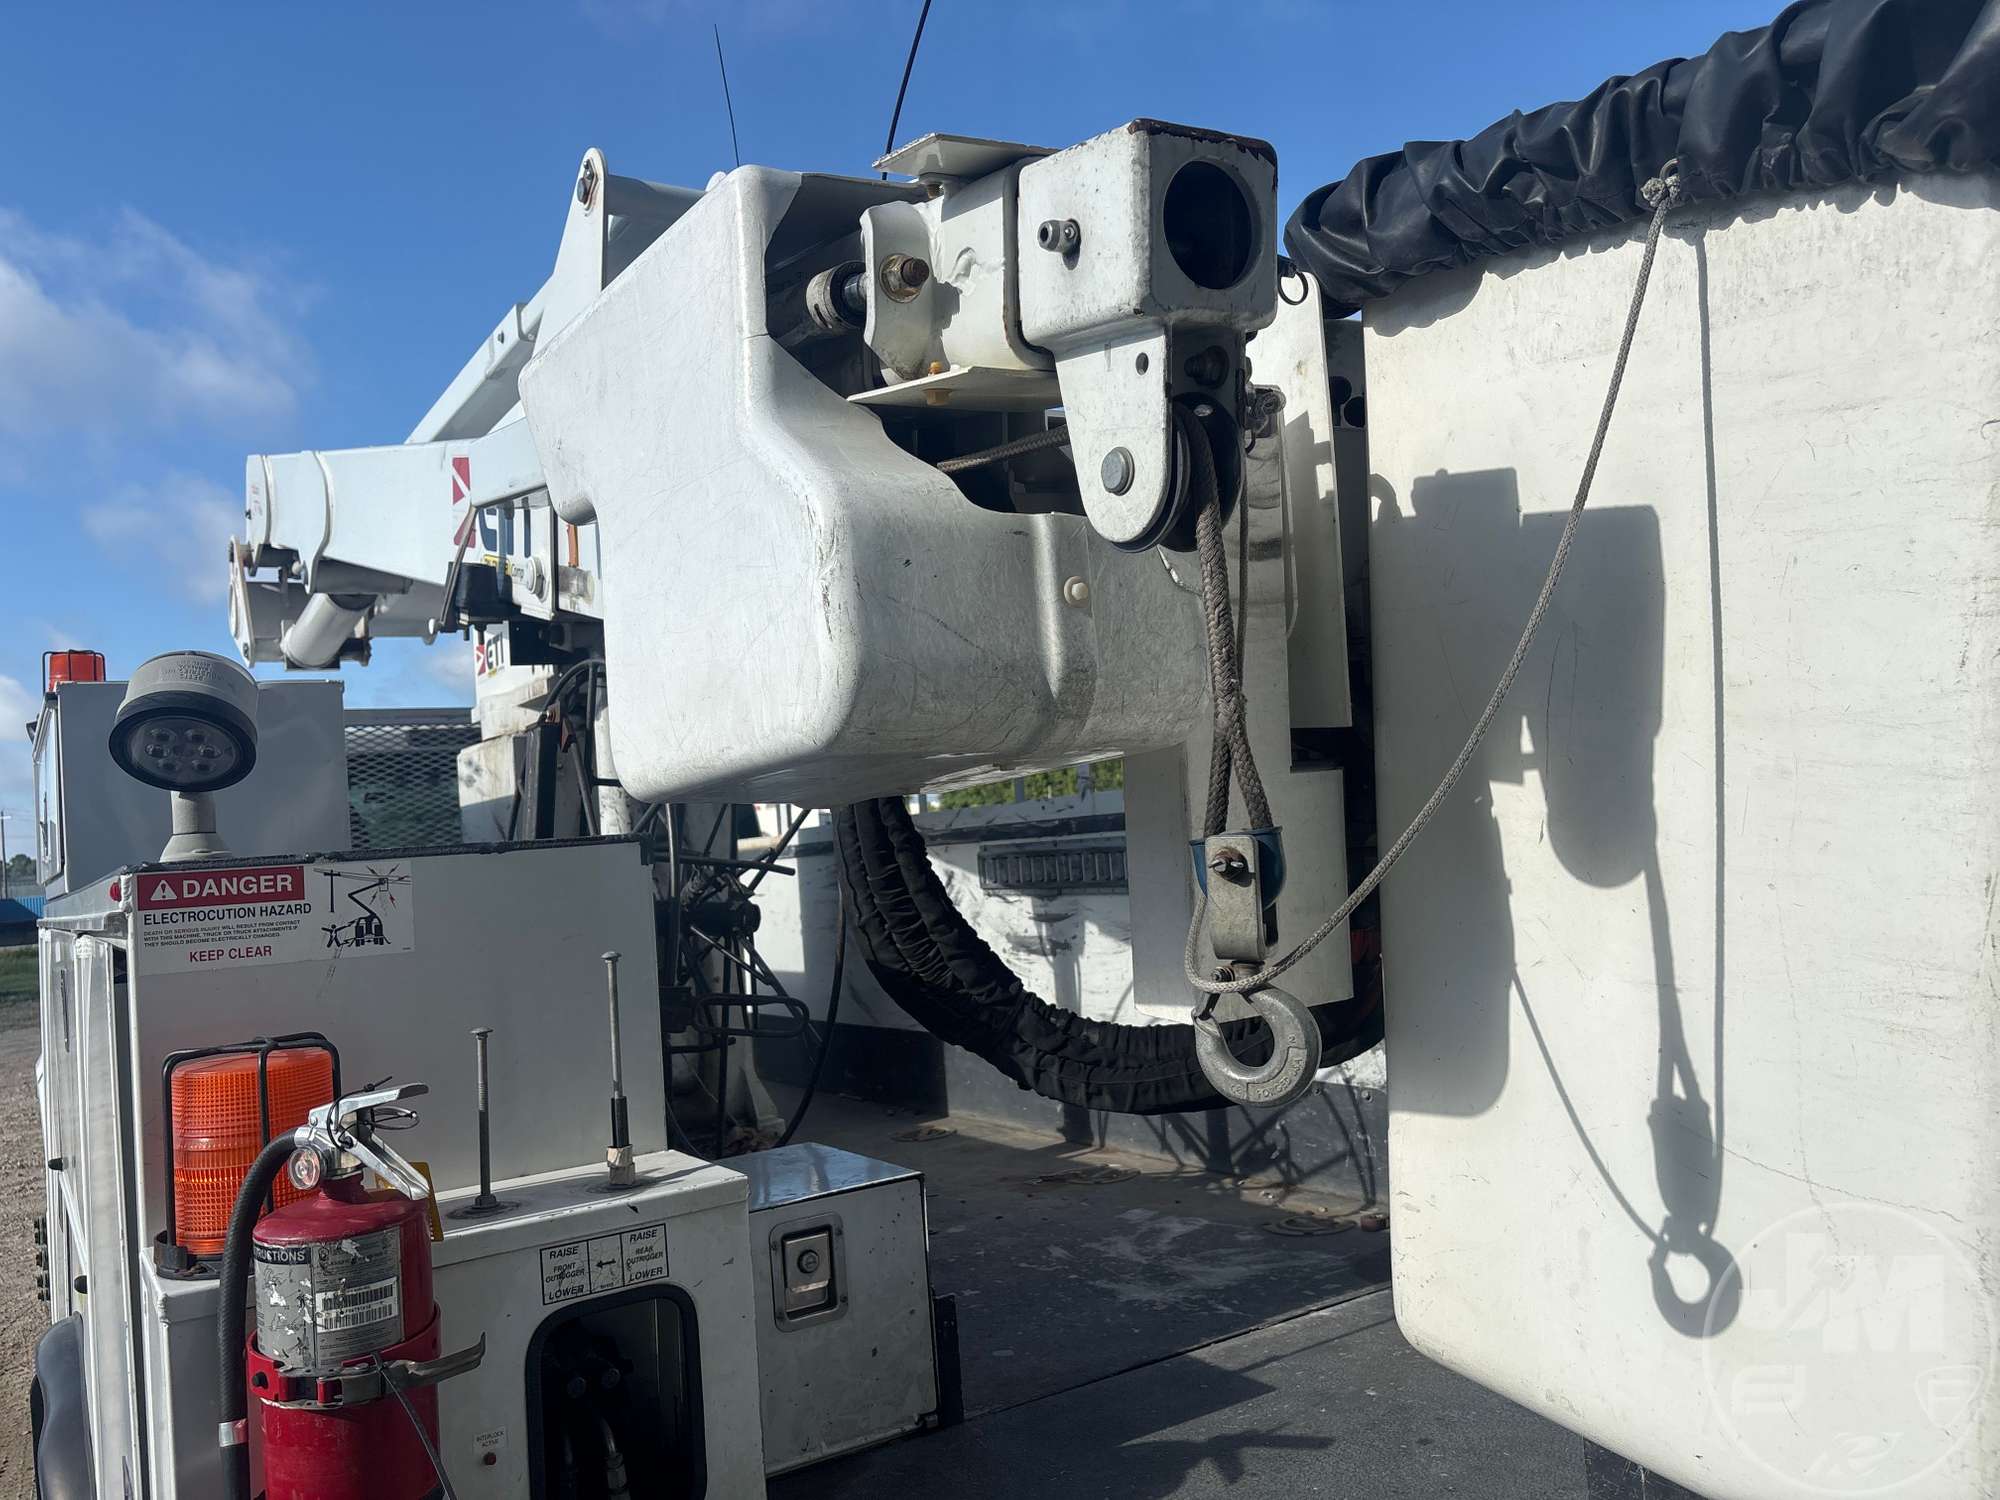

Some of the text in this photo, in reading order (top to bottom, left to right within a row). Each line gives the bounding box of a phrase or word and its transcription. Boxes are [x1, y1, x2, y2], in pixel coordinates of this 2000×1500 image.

[182, 874, 293, 899] DANGER
[144, 903, 312, 926] ELECTROCUTION HAZARD
[174, 927, 199, 935] SERIOUS
[236, 922, 257, 930] RESULT
[275, 919, 301, 927] CONTACT
[233, 928, 252, 936] TRUCK
[253, 925, 292, 935] ATTACHMENTS
[160, 939, 184, 947] SHOULD
[185, 936, 210, 945] BECOME
[211, 934, 251, 944] ELECTRICALLY
[189, 945, 273, 963] KEEP CLEAR
[629, 1229, 657, 1243] RAISE
[549, 1245, 579, 1260] RAISE
[635, 1246, 654, 1255] REAR
[554, 1262, 576, 1274] FRONT
[629, 1266, 663, 1282] LOWER
[548, 1284, 584, 1300] LOWER
